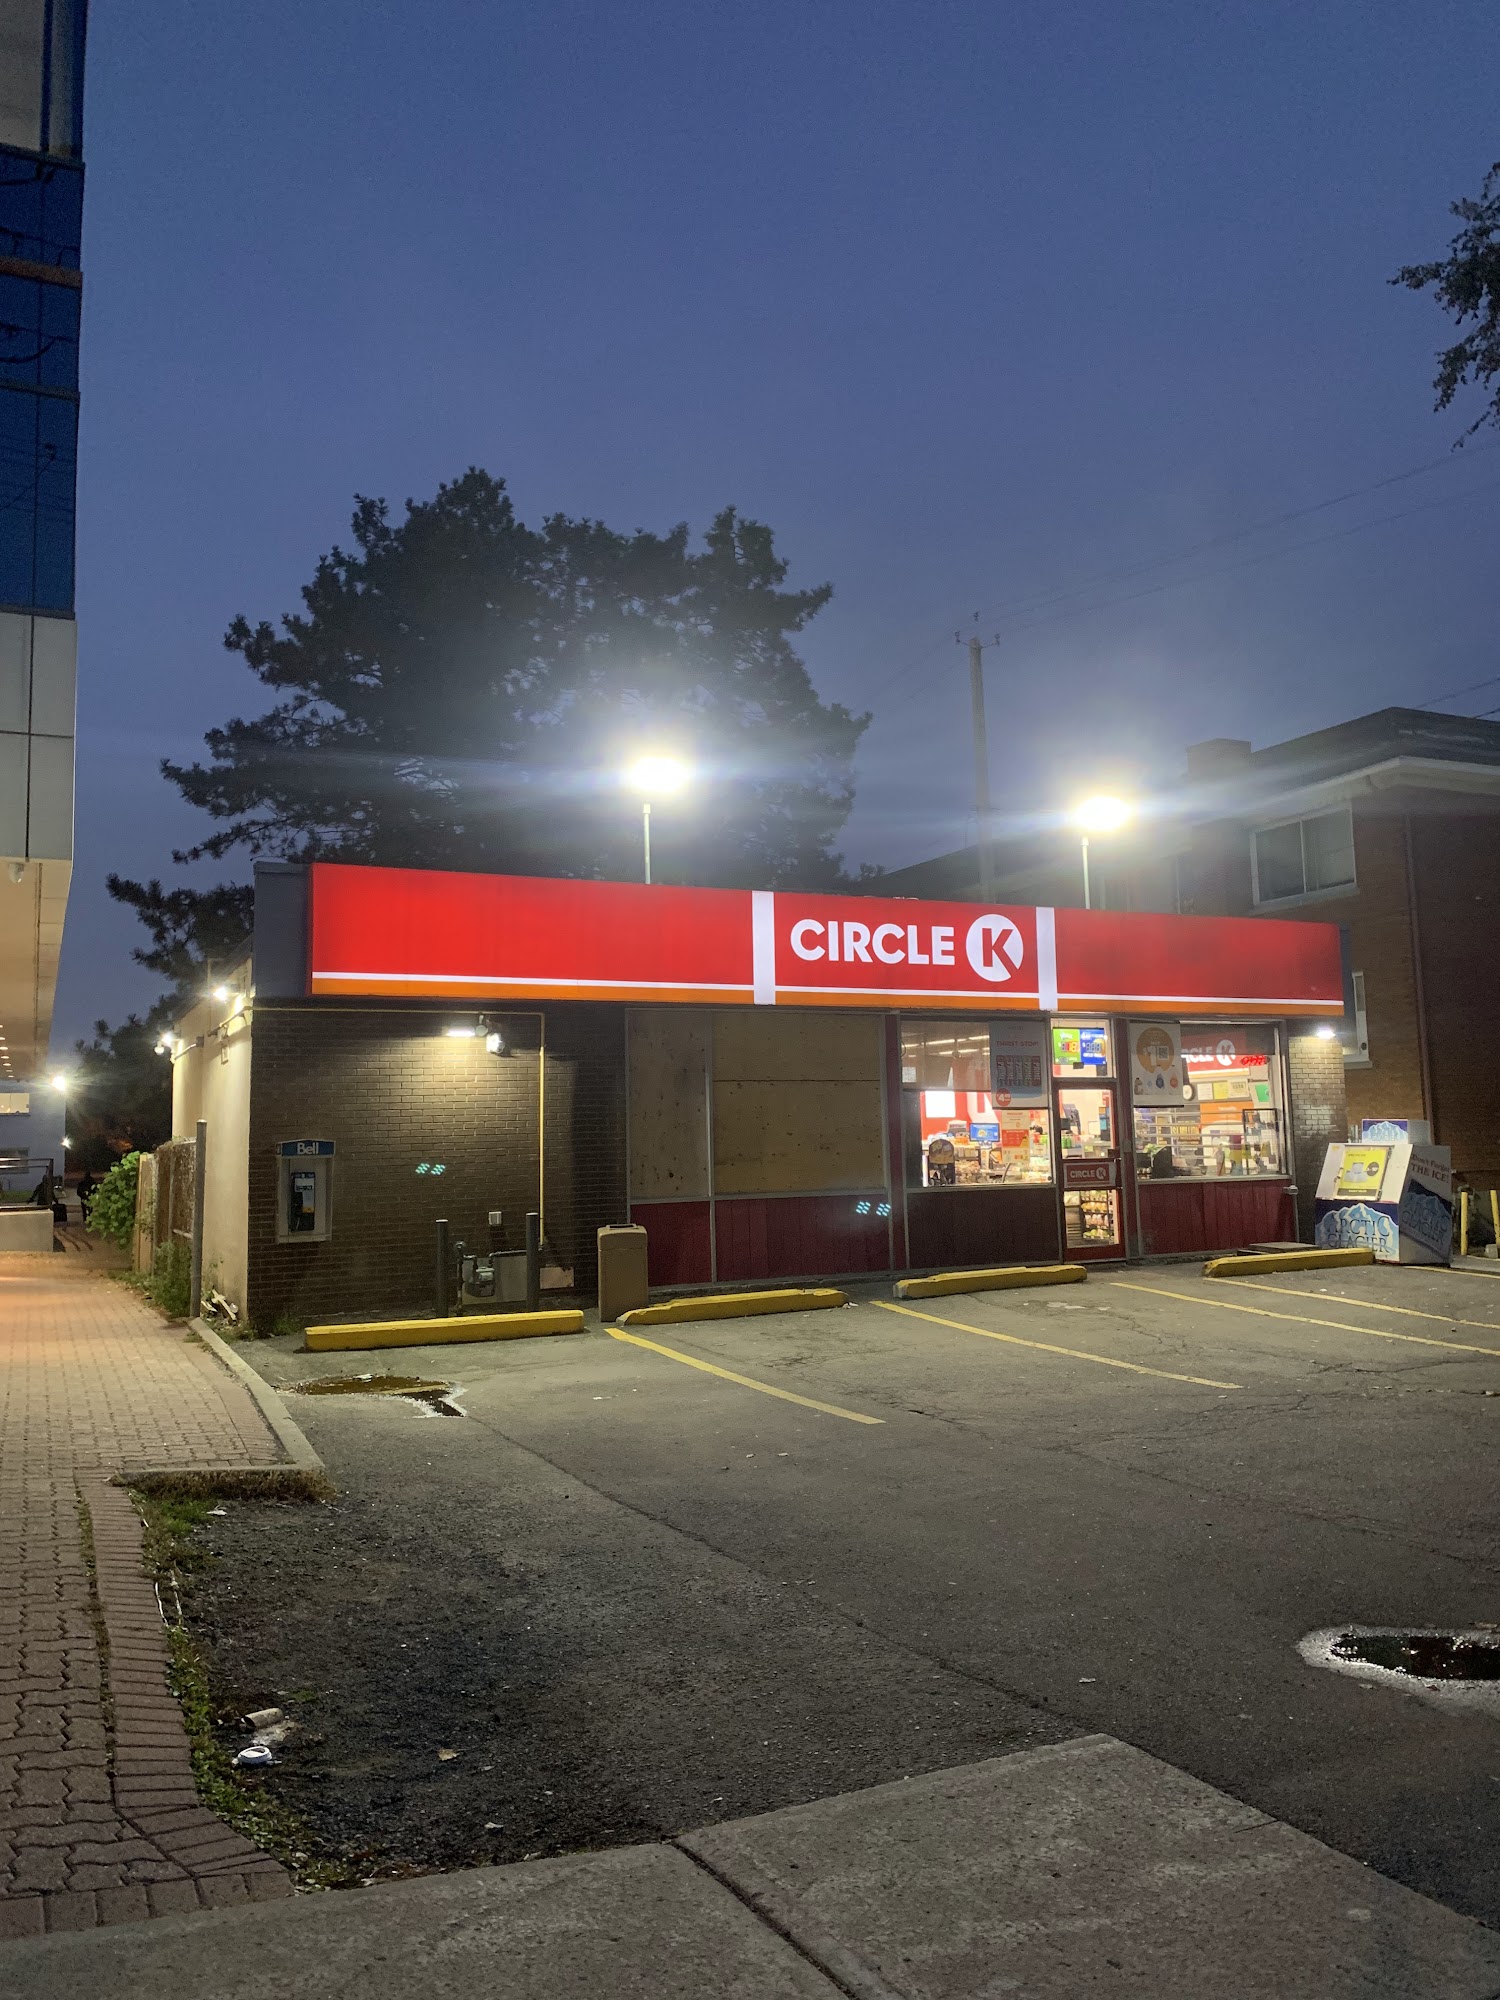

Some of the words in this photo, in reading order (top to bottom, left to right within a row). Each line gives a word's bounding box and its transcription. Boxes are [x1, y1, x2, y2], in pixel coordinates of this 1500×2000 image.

[790, 918, 956, 966] CIRCLE
[974, 920, 1022, 980] K
[1216, 1040, 1235, 1066] K
[297, 1142, 319, 1155] Bell
[1069, 1169, 1095, 1178] CIRCLE
[1096, 1167, 1106, 1180] K
[1411, 1163, 1430, 1177] THE
[1328, 1212, 1391, 1237] ARCTIC
[1327, 1233, 1390, 1253] GLACIER
